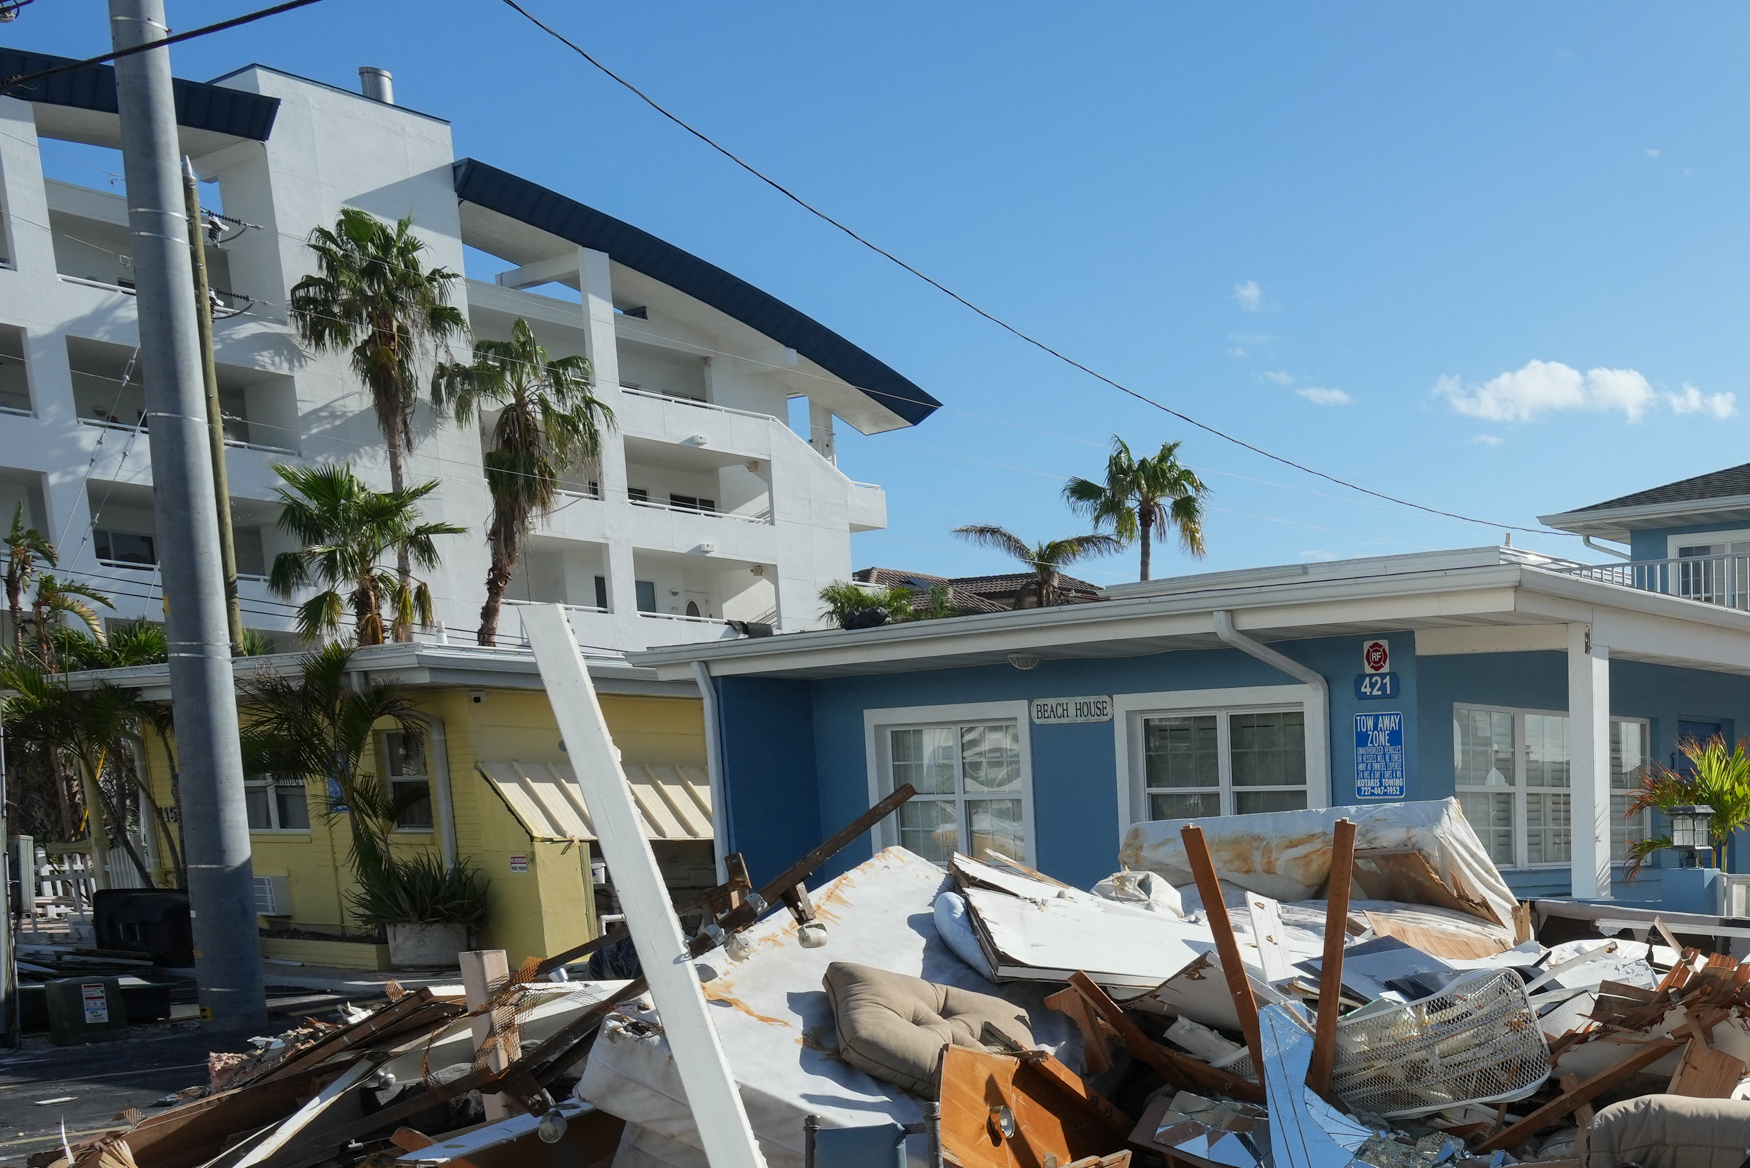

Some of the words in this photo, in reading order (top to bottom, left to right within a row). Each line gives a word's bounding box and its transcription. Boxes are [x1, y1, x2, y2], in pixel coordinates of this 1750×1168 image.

[1371, 652, 1382, 662] RF
[1361, 675, 1391, 696] 421
[1036, 702, 1069, 719] BEACH
[1075, 700, 1109, 718] HOUSE
[1356, 716, 1374, 732] TOW
[1378, 715, 1400, 731] AWAY
[1368, 731, 1390, 746] ZONE
[1382, 778, 1403, 786] TOWING
[1361, 787, 1400, 795] 727-447-1952
